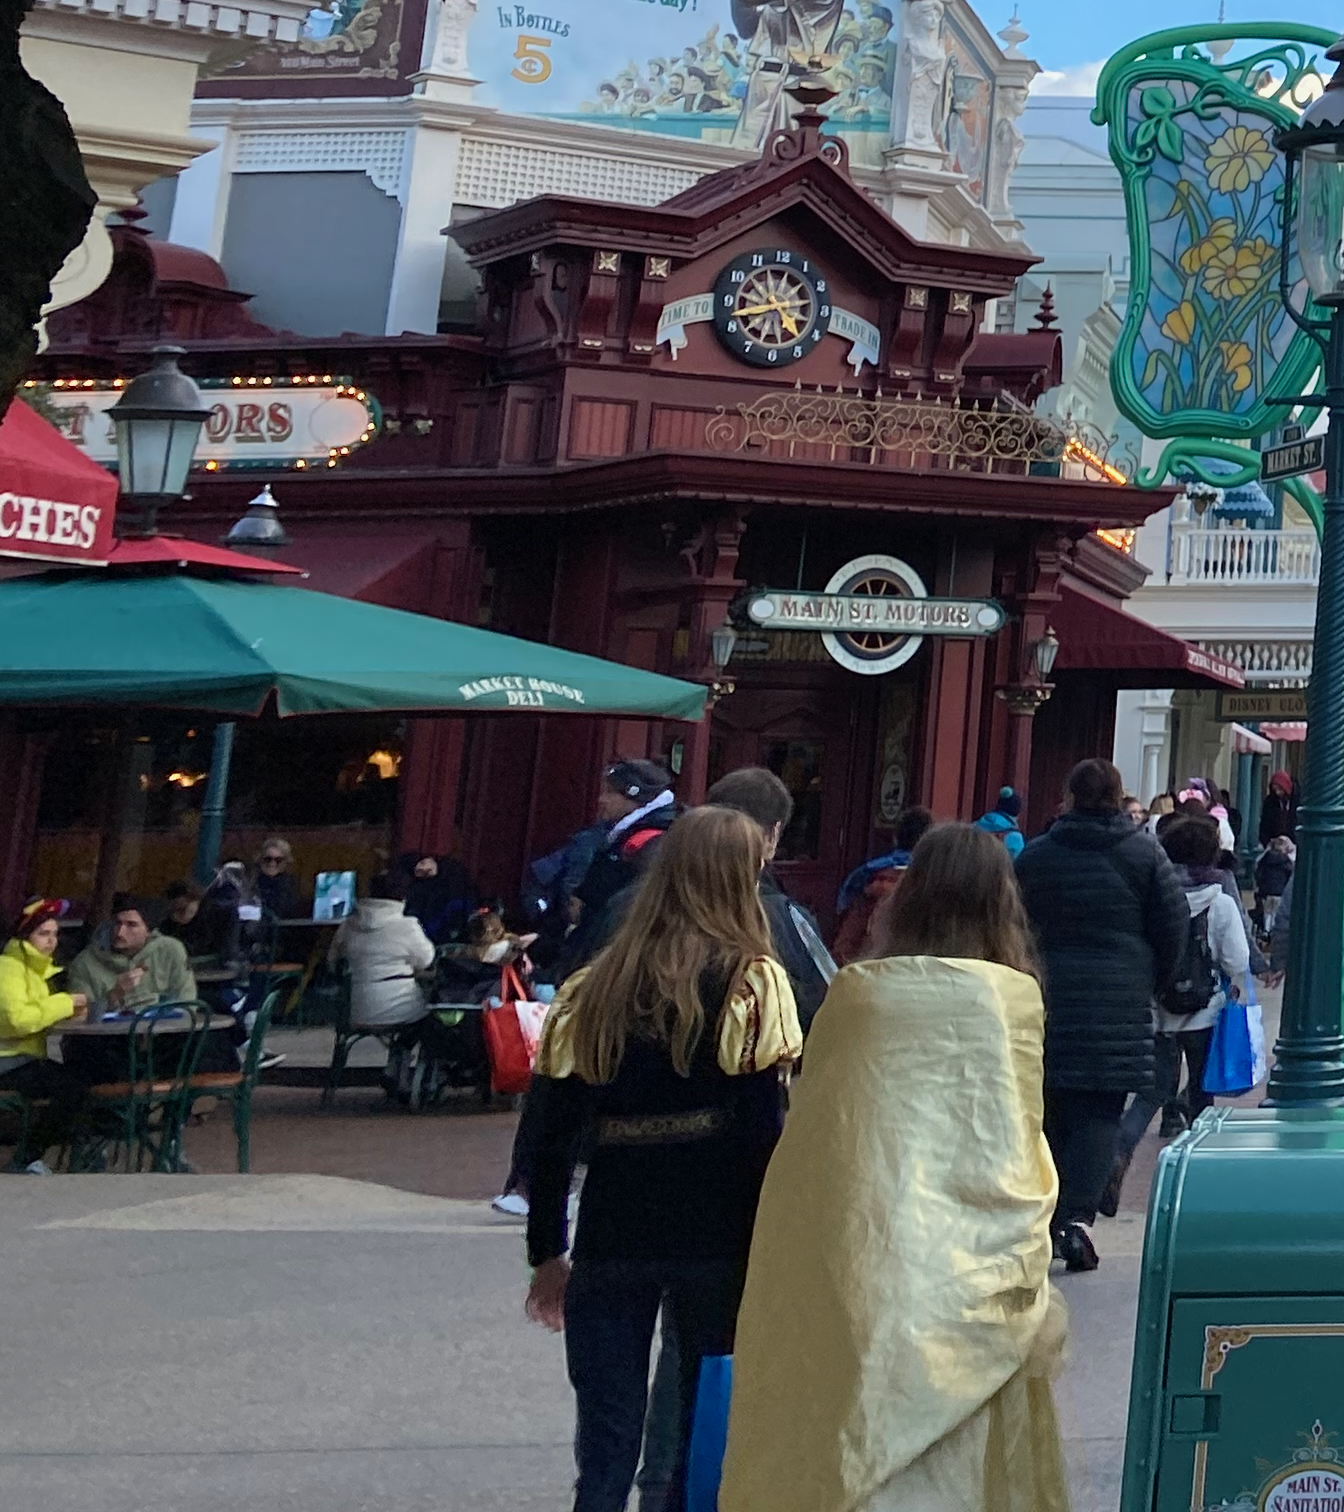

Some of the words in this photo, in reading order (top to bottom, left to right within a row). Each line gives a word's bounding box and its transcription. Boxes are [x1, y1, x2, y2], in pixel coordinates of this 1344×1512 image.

[752, 254, 764, 267] 11
[775, 250, 791, 263] 12
[802, 260, 810, 273] 1
[730, 270, 745, 283] 10
[816, 279, 826, 292] 2
[723, 294, 734, 307] 9
[660, 304, 690, 327] TIME
[693, 301, 709, 315] TO
[819, 305, 830, 318] 3
[727, 320, 738, 333] 8
[834, 313, 866, 342] TRADE
[867, 329, 878, 349] IN
[811, 329, 821, 342] 4
[743, 341, 753, 353] 7
[793, 345, 803, 359] 5
[767, 349, 778, 362] 6
[1266, 446, 1302, 474] MARKET
[1303, 442, 1317, 465] ST.
[779, 596, 843, 625] MAIN
[849, 602, 879, 623] ST.
[885, 604, 972, 629] MOTORS
[458, 675, 524, 701] MARKET
[527, 677, 586, 705] HOUSE
[506, 690, 545, 706] DELI
[1230, 697, 1273, 712] DISNEY
[1280, 698, 1305, 712] CLO
[1286, 1476, 1321, 1494] MAIN
[1323, 1477, 1342, 1494] ST.
